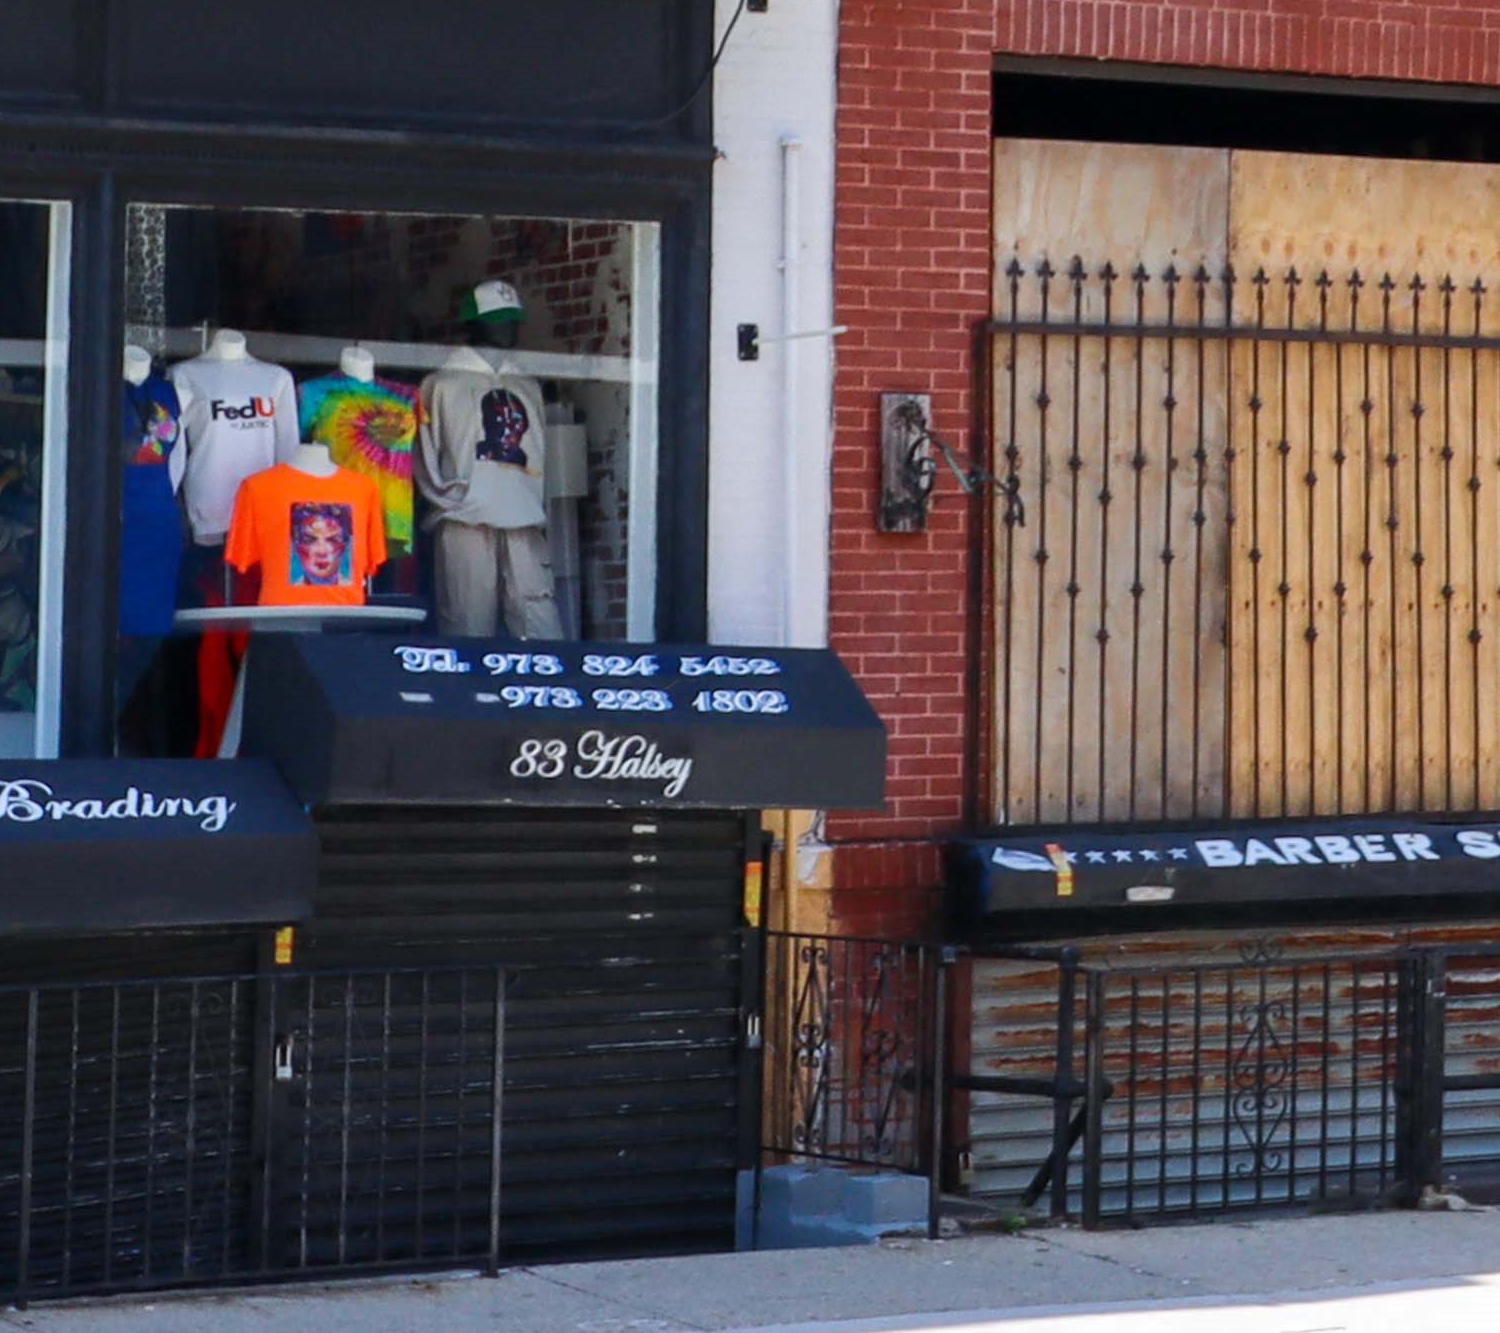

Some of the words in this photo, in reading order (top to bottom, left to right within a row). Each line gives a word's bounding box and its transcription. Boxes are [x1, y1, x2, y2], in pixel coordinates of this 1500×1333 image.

[482, 653, 564, 675] 973
[582, 654, 659, 676] 824
[679, 656, 781, 676] 5452
[592, 688, 673, 711] 223
[692, 689, 789, 713] 1802
[510, 739, 567, 778] 83
[573, 729, 693, 798] Halsey
[1195, 832, 1440, 867] BARBER
